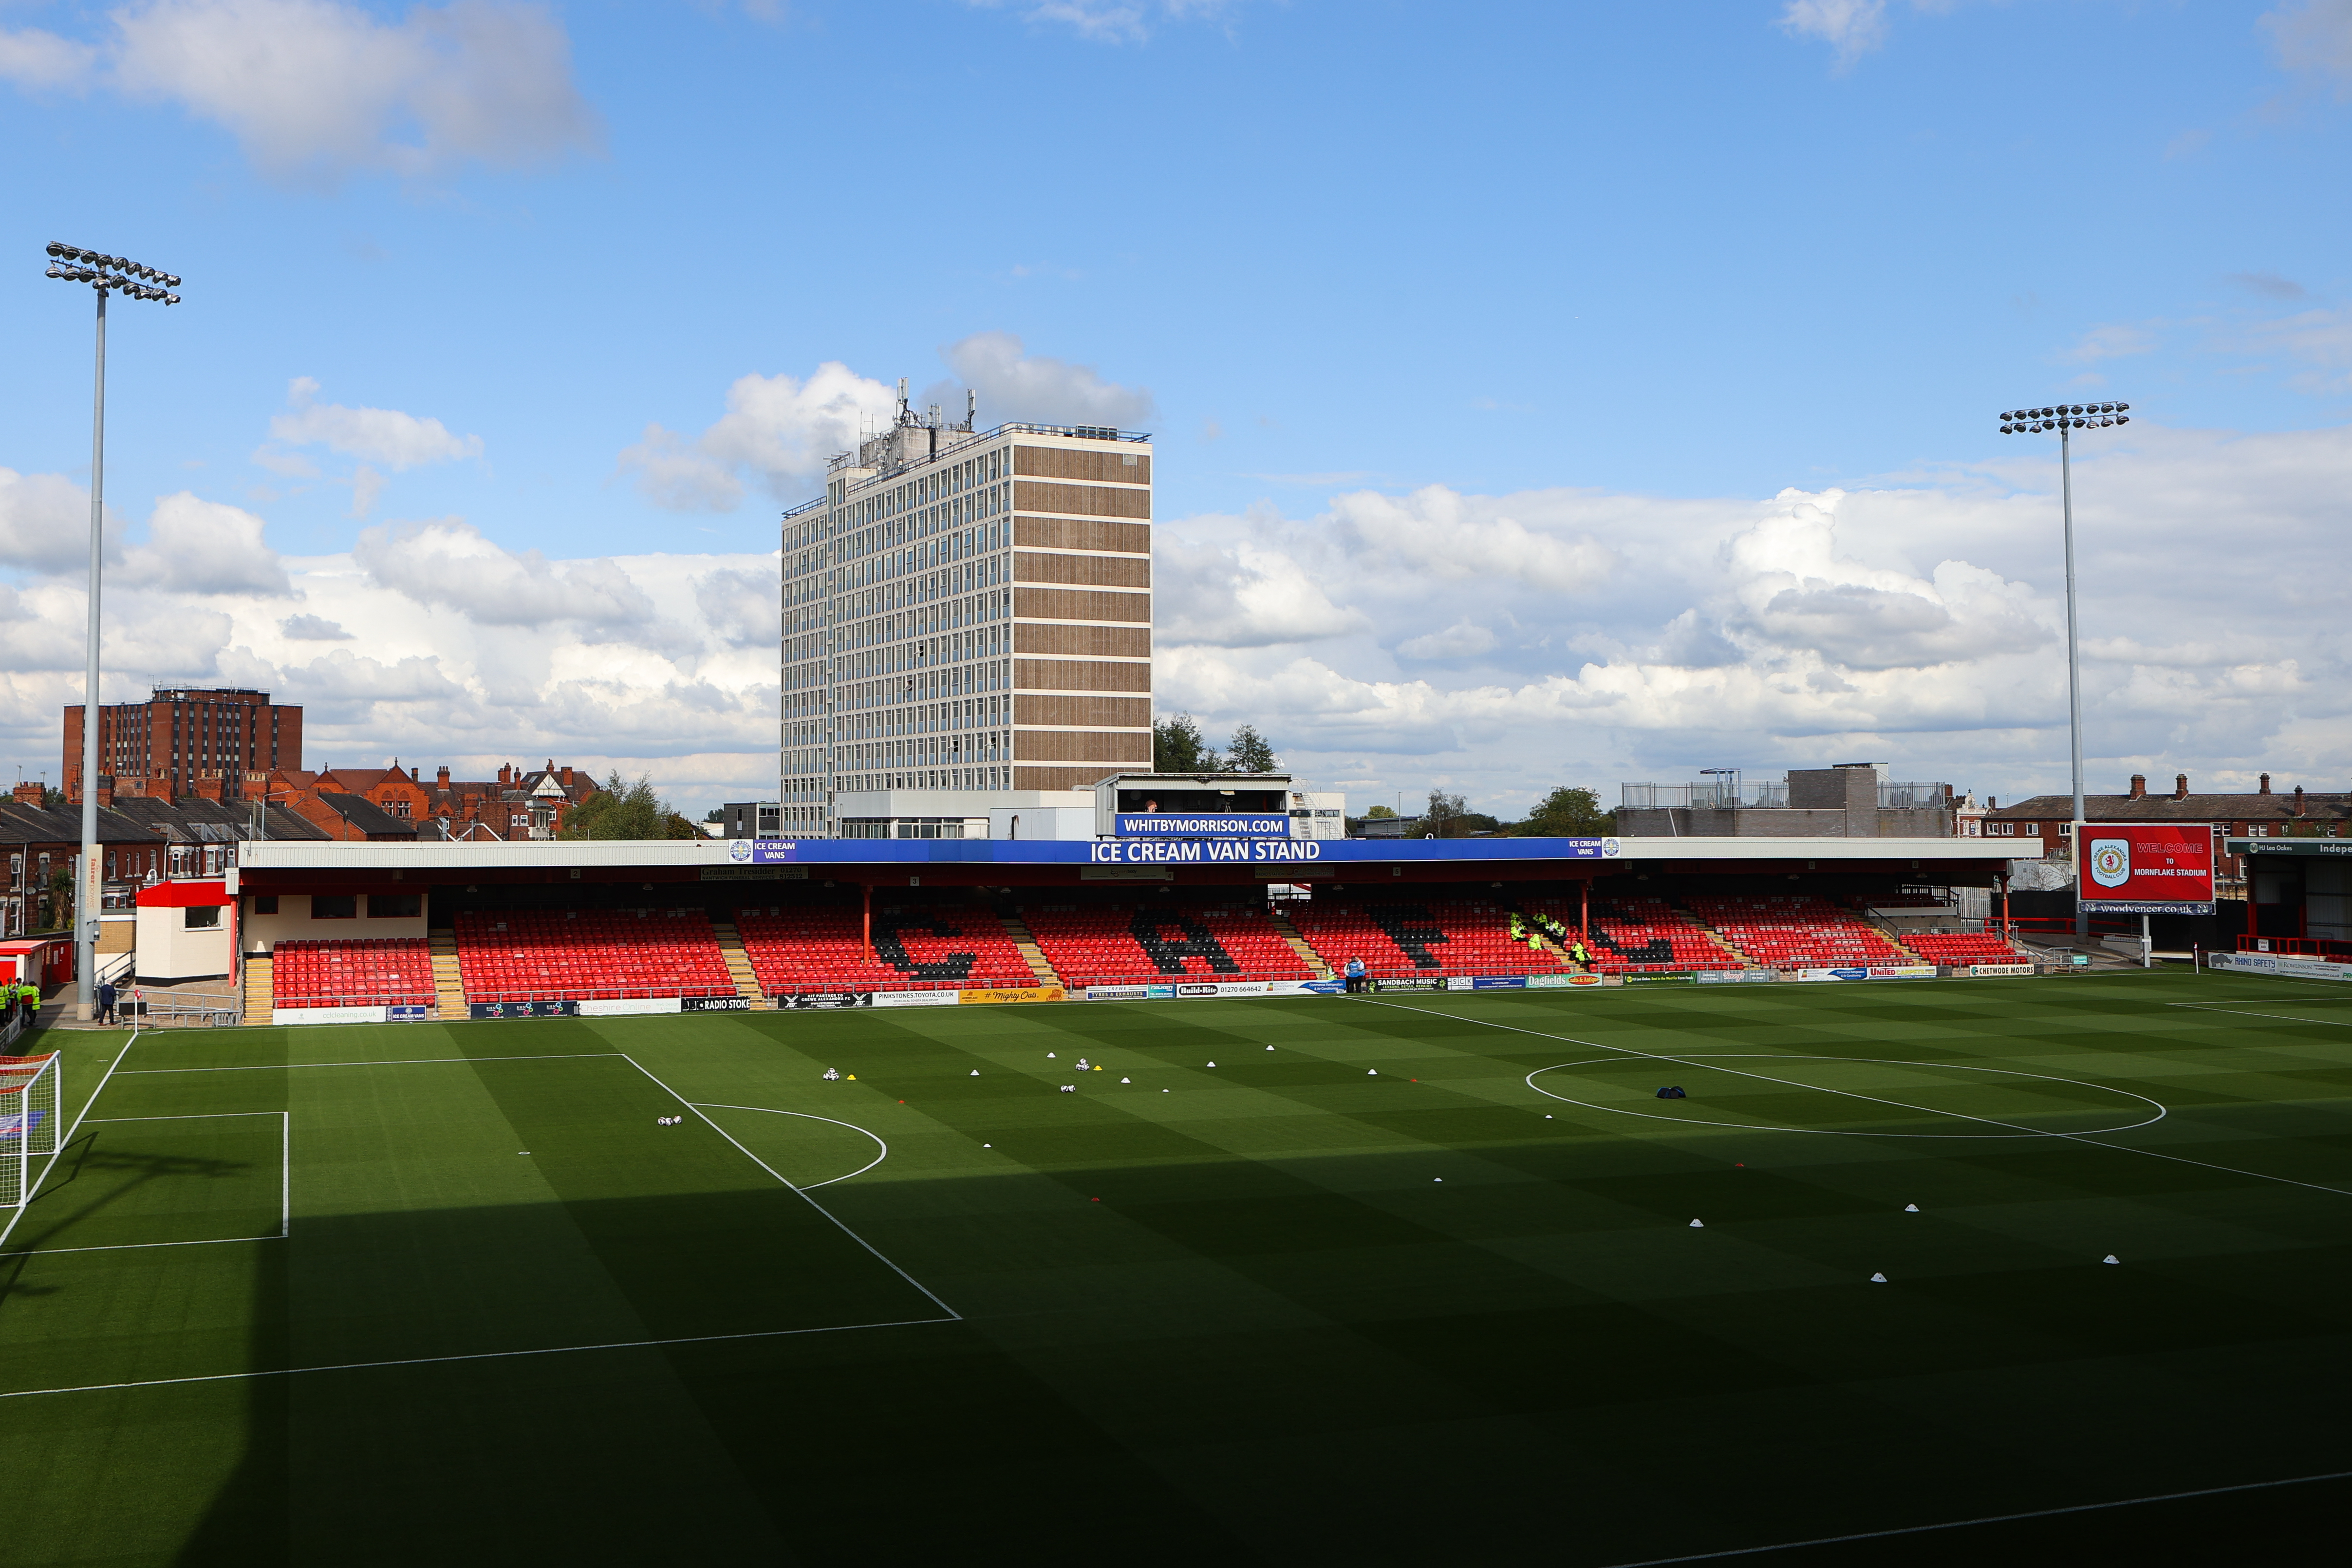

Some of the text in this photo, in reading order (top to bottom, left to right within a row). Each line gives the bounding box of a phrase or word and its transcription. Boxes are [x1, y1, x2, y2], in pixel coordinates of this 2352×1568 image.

[1124, 819, 1283, 832] WHITBYMORRISON.COM
[1091, 841, 1320, 861] ICE CREAM VAN STAND
[2093, 845, 2128, 862] CREWE ALEXANDRA
[2137, 843, 2203, 853] WELCOME
[2095, 867, 2126, 878] FOOTBALL CLUB
[2101, 904, 2193, 913] woodveneer.co.uk
[2235, 957, 2276, 968] RHINO SAFETY
[1529, 976, 1566, 987] Dagfields
[1723, 971, 1745, 982] Benny's
[993, 991, 1020, 1002] Mighty
[580, 1002, 651, 1012] Cheshire Online
[705, 1000, 727, 1009] RADIO
[728, 999, 750, 1009] STOKE
[323, 1010, 376, 1019] cclcleaning.co.uk
